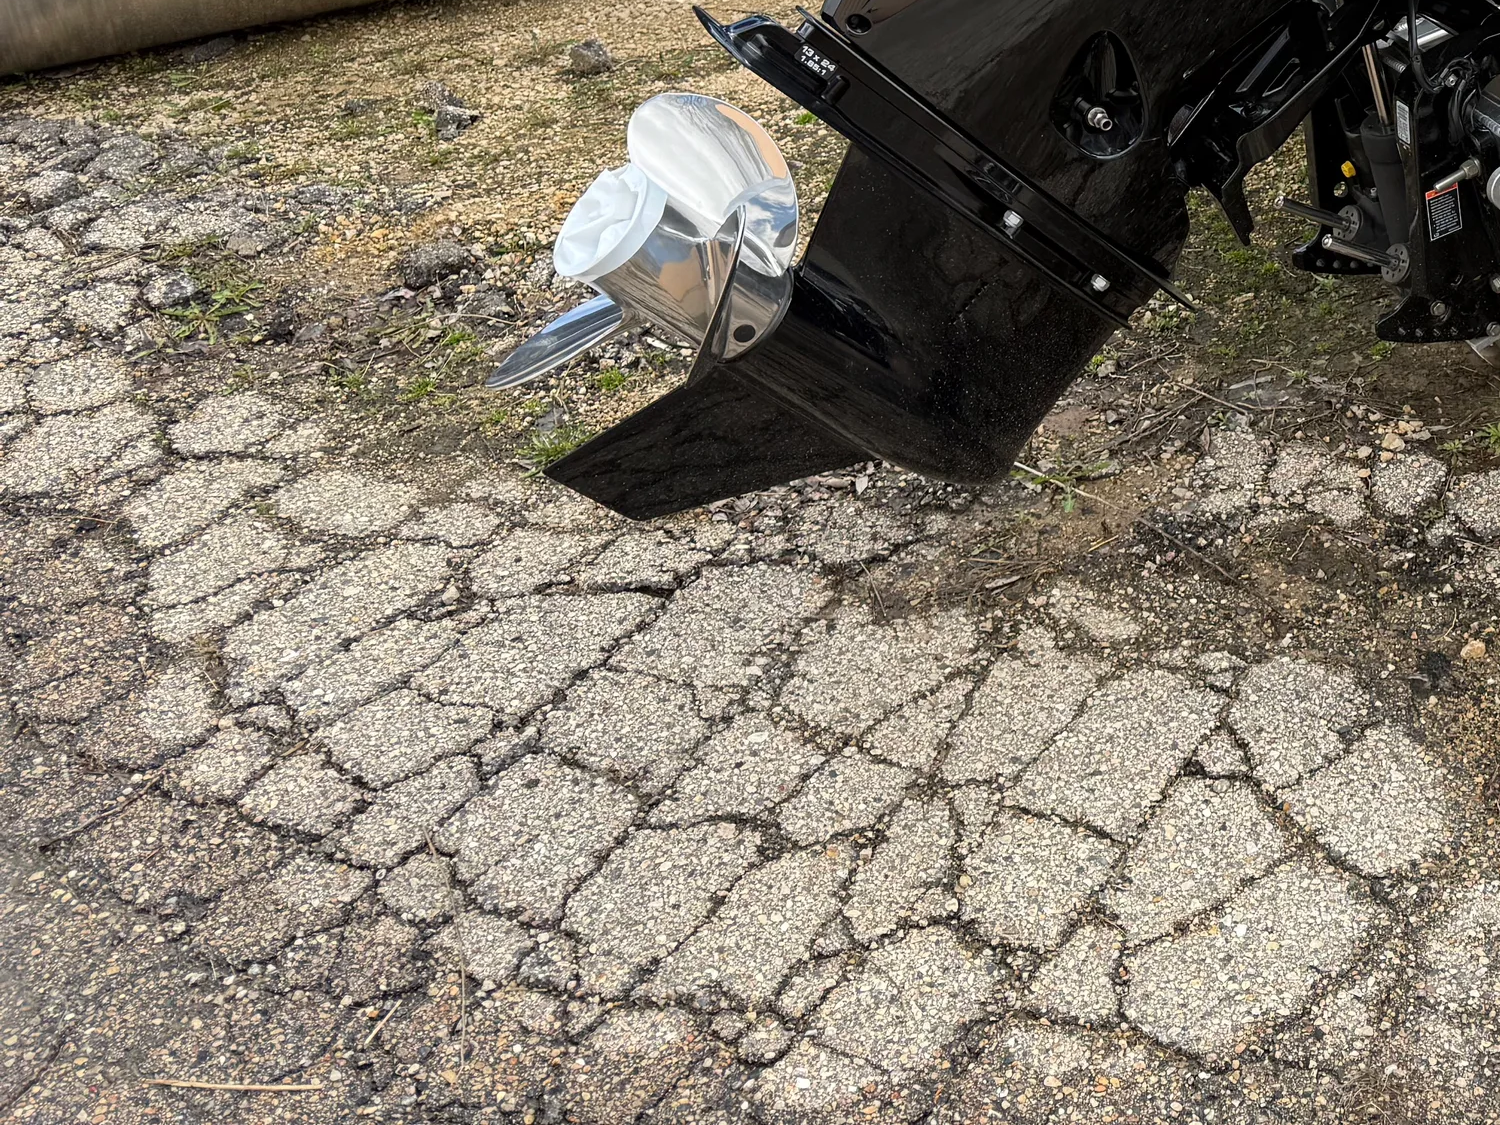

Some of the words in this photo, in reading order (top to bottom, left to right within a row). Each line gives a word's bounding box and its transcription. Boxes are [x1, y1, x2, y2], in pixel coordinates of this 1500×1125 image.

[802, 45, 815, 57] 13
[812, 54, 820, 62] x
[820, 59, 836, 72] 24
